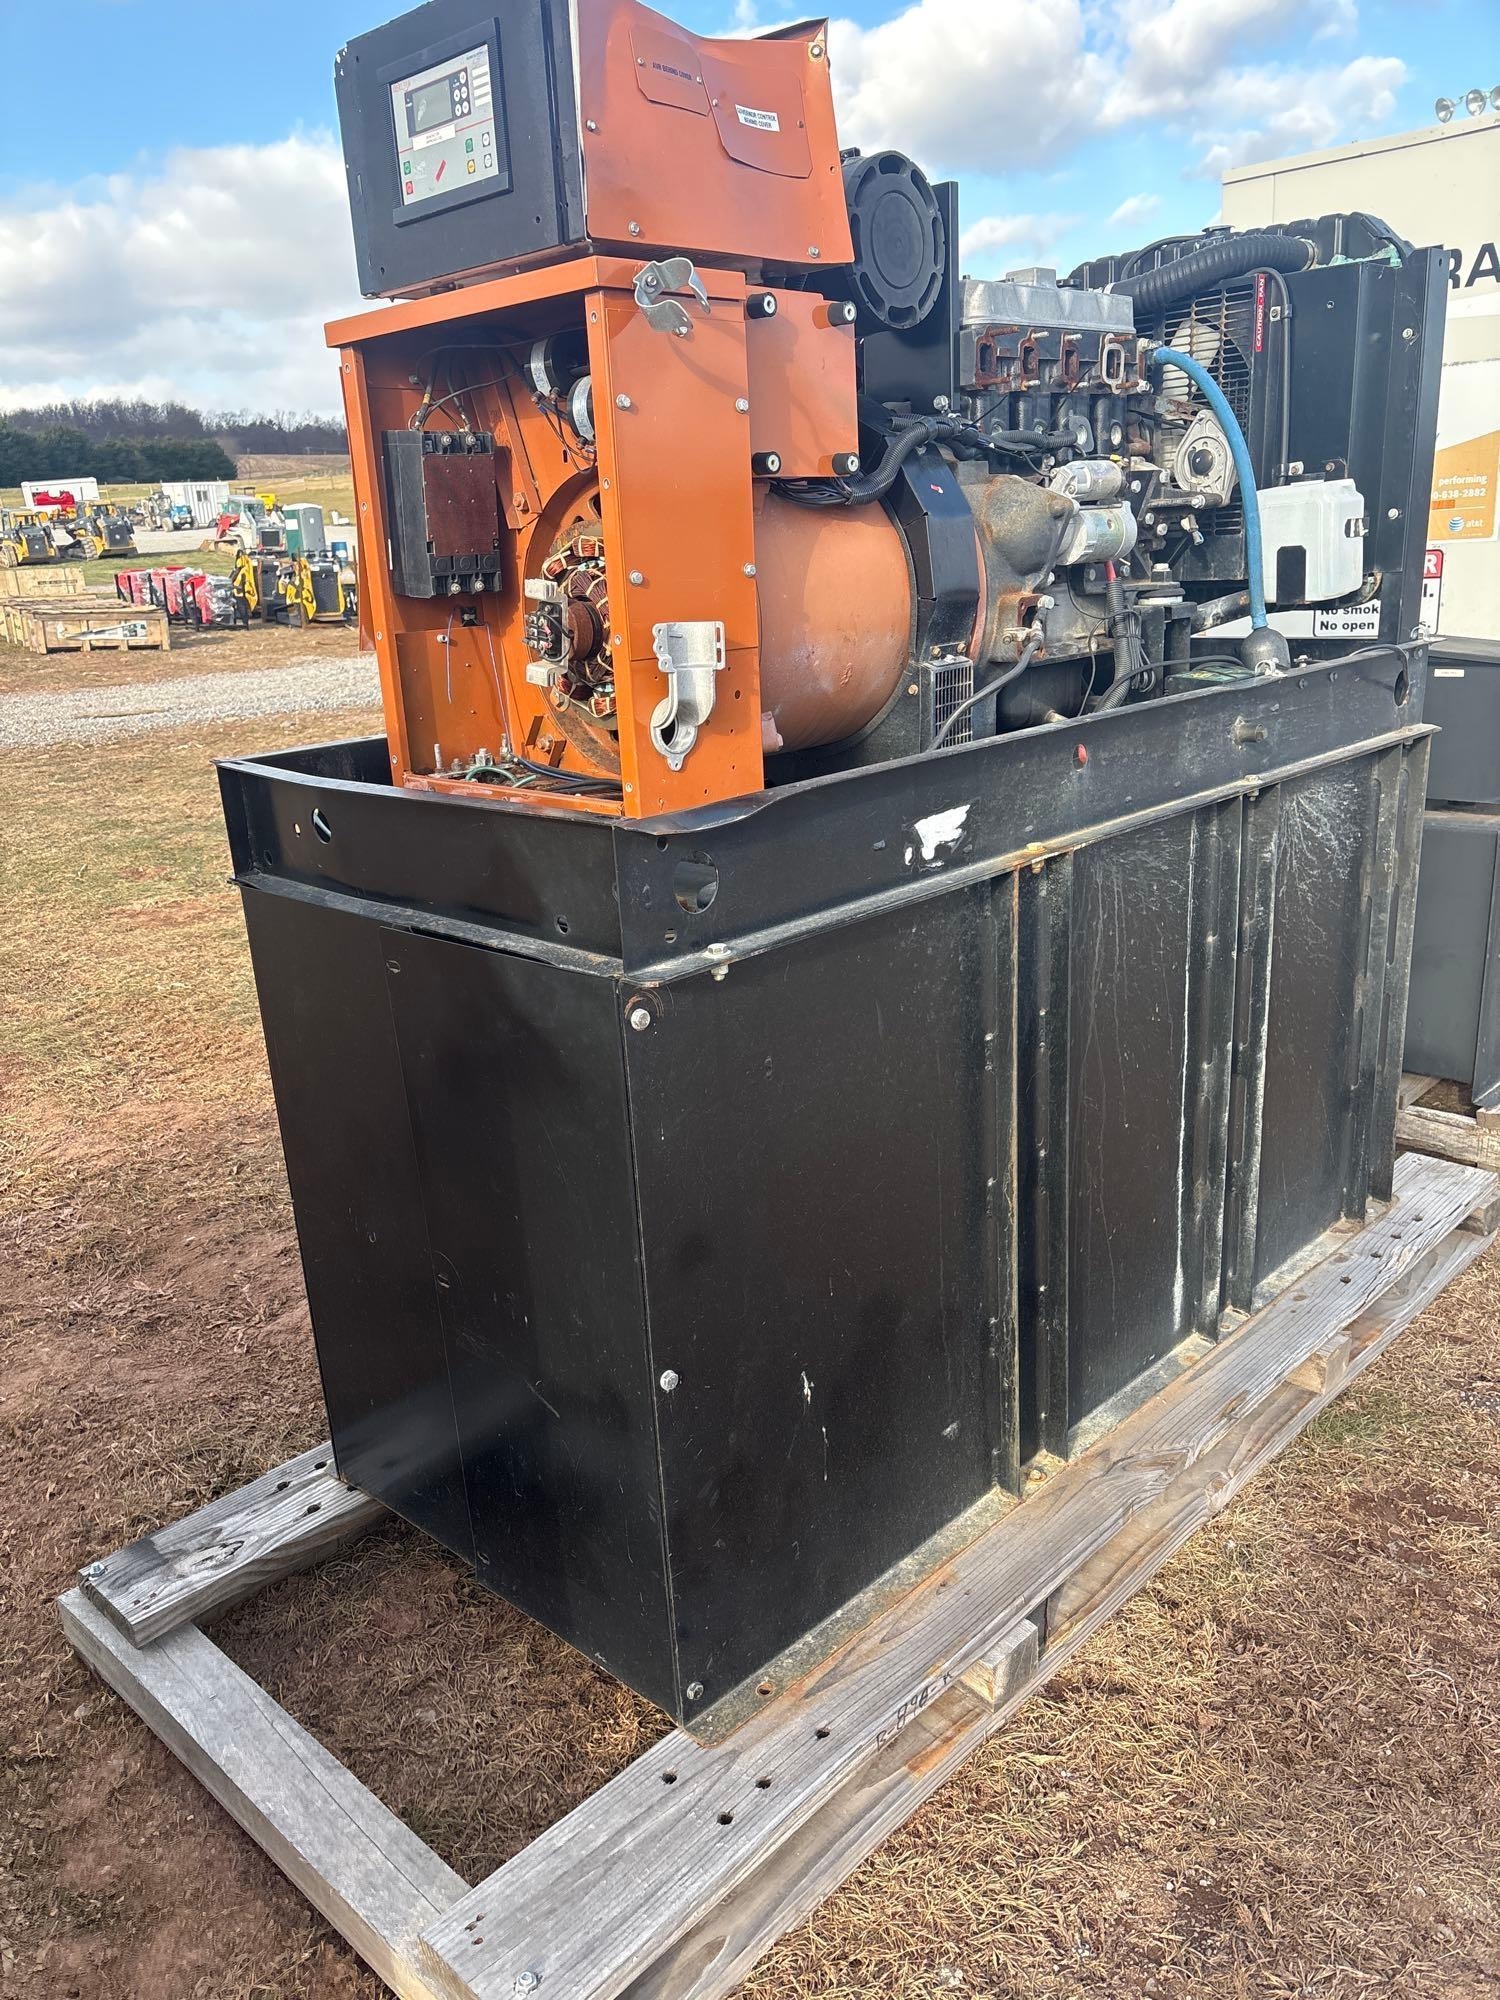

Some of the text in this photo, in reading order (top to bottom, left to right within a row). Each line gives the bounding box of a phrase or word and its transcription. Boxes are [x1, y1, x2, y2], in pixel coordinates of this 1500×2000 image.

[756, 112, 777, 122] CONTROL
[758, 120, 773, 129] COVER
[1256, 305, 1264, 347] CAUTION
[1438, 475, 1488, 487] performing
[1320, 620, 1375, 632] No open
